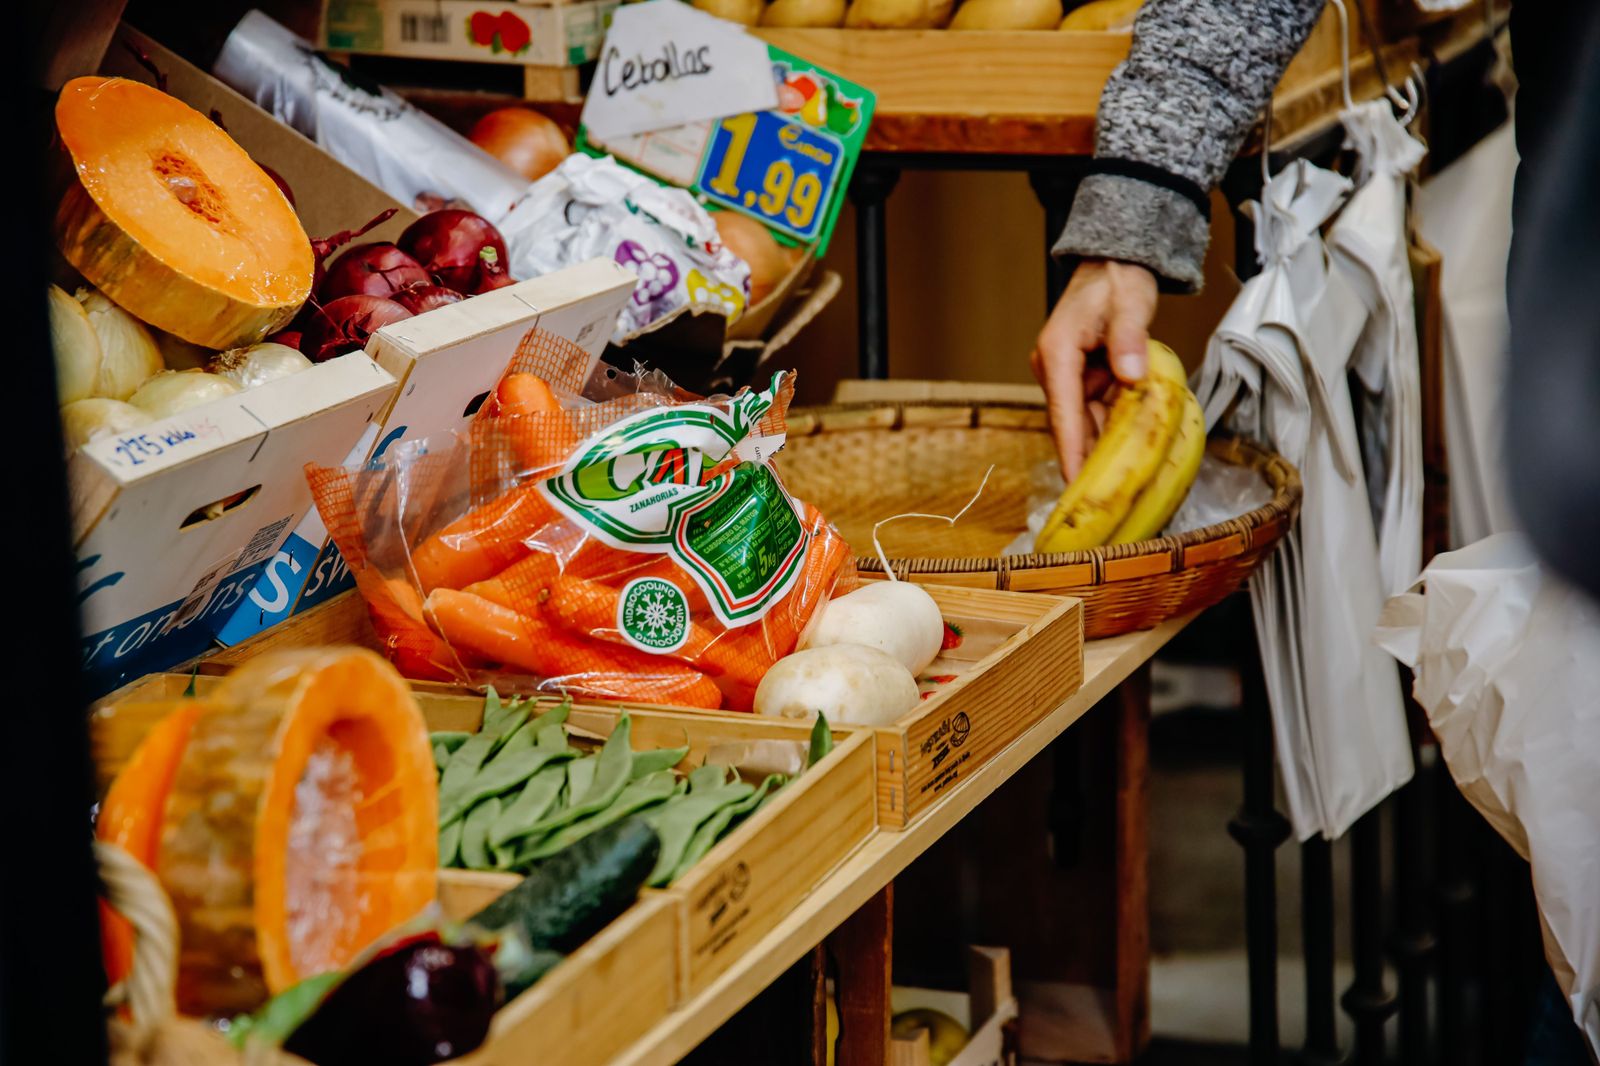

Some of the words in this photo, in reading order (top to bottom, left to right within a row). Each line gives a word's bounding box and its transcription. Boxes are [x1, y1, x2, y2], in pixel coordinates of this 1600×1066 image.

[603, 41, 713, 96] Cebollas
[709, 111, 822, 228] 1,99
[629, 486, 679, 514] ZANAHORIAS
[703, 529, 734, 554] CARBONERO
[733, 523, 741, 532] EL
[740, 508, 759, 526] MAYOR
[625, 582, 676, 627] HIDROCOOLING
[635, 604, 684, 647] HIDROCOOLING
